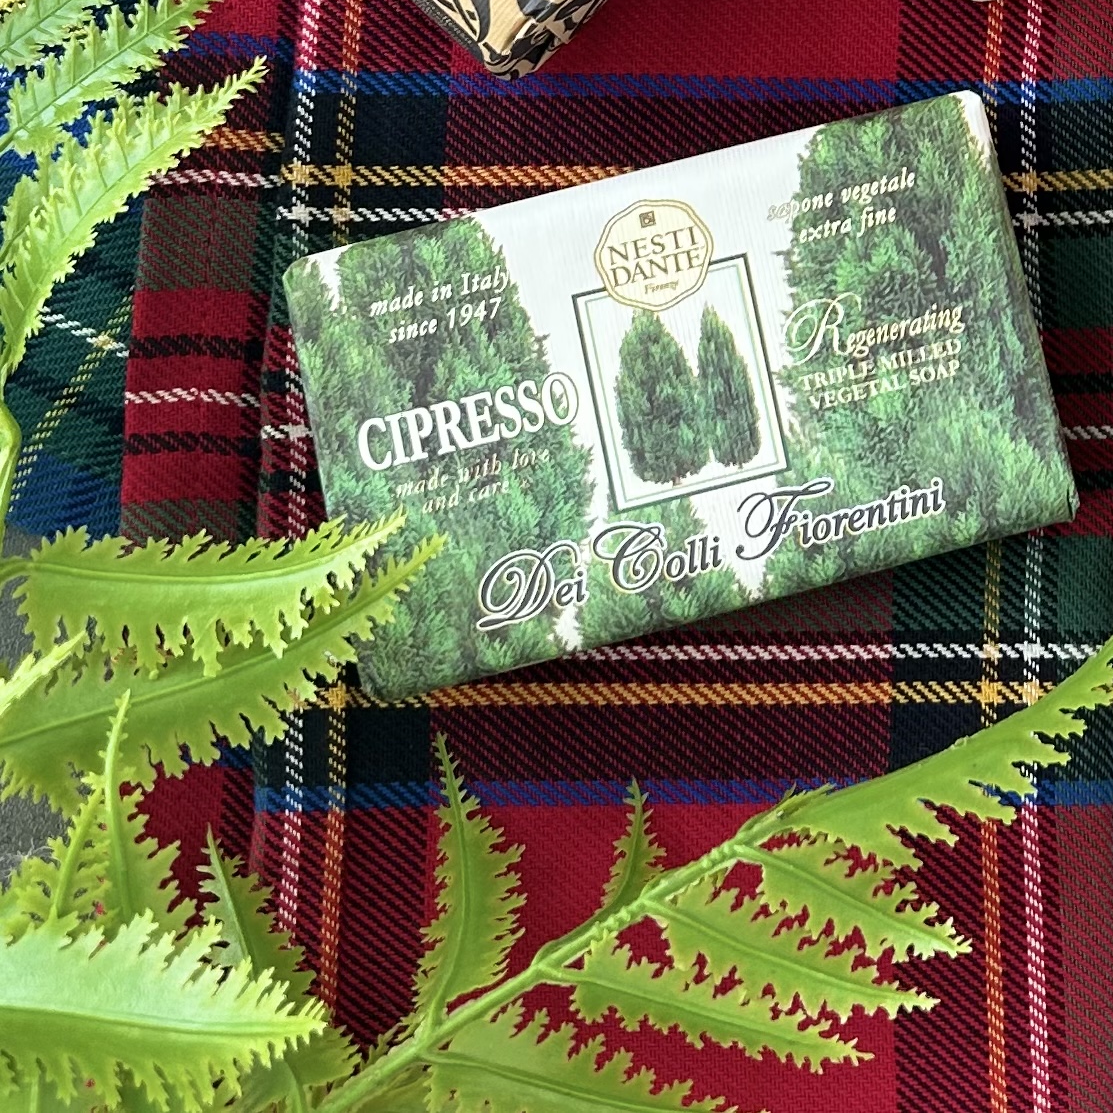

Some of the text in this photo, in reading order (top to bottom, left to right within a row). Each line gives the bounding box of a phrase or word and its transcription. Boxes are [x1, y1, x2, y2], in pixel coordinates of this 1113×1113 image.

[766, 166, 917, 227] sapone vegetale
[606, 225, 699, 265] NESTI
[799, 206, 898, 243] extra fine
[367, 262, 513, 317] made in Italy
[609, 246, 704, 288] DANTE
[386, 296, 504, 344] since 1947
[782, 291, 966, 366] Regenerating
[799, 337, 963, 391] TRIPLE MILLED
[808, 358, 961, 411] VEGETAL SOAP
[353, 368, 583, 474] CIPRESSO
[477, 479, 946, 629] Dei Colli Fiorentini
